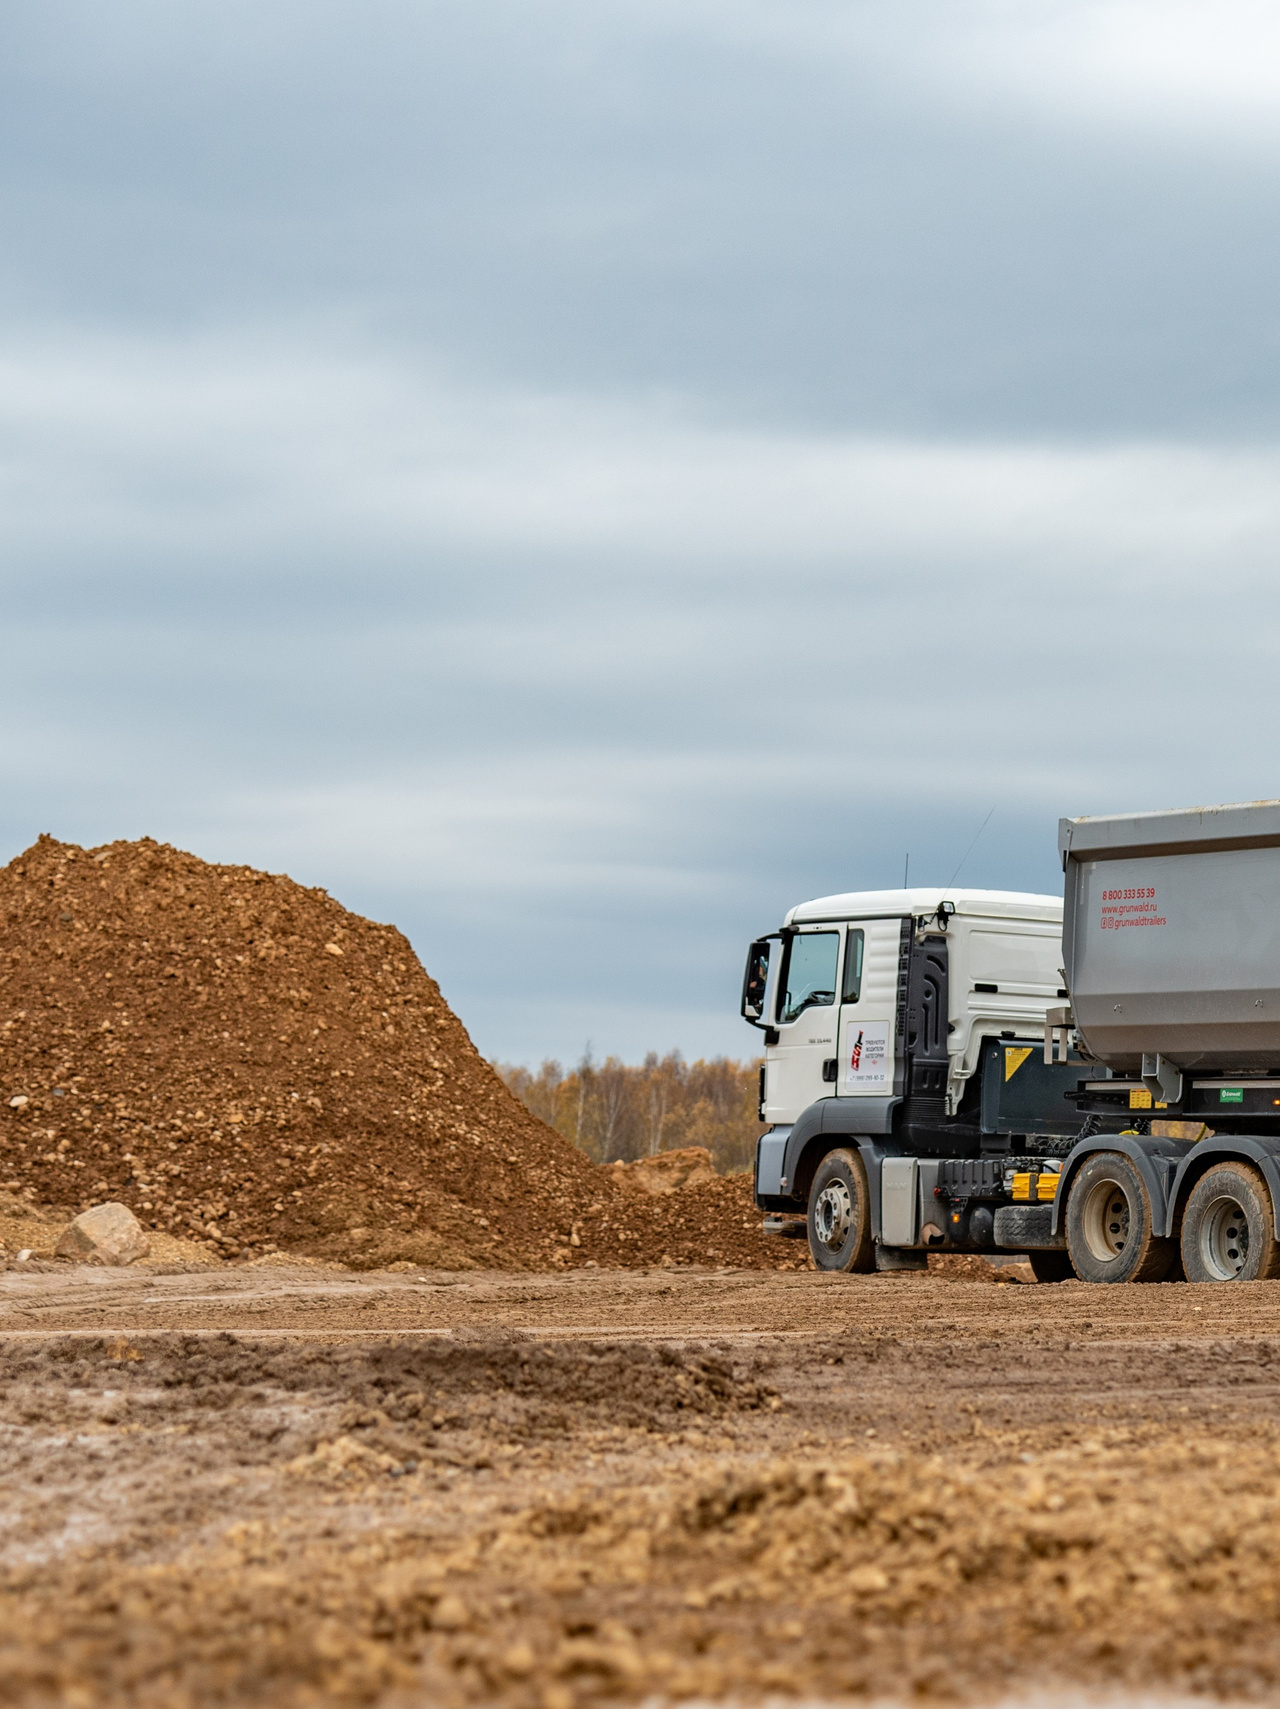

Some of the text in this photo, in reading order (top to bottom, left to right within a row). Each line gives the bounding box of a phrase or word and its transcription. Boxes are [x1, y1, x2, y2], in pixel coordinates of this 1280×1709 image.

[1102, 887, 1155, 900] 8 800 333 55 39
[1101, 902, 1157, 916] www.grunwald.ru
[1114, 916, 1167, 930] grunwaldtrailers
